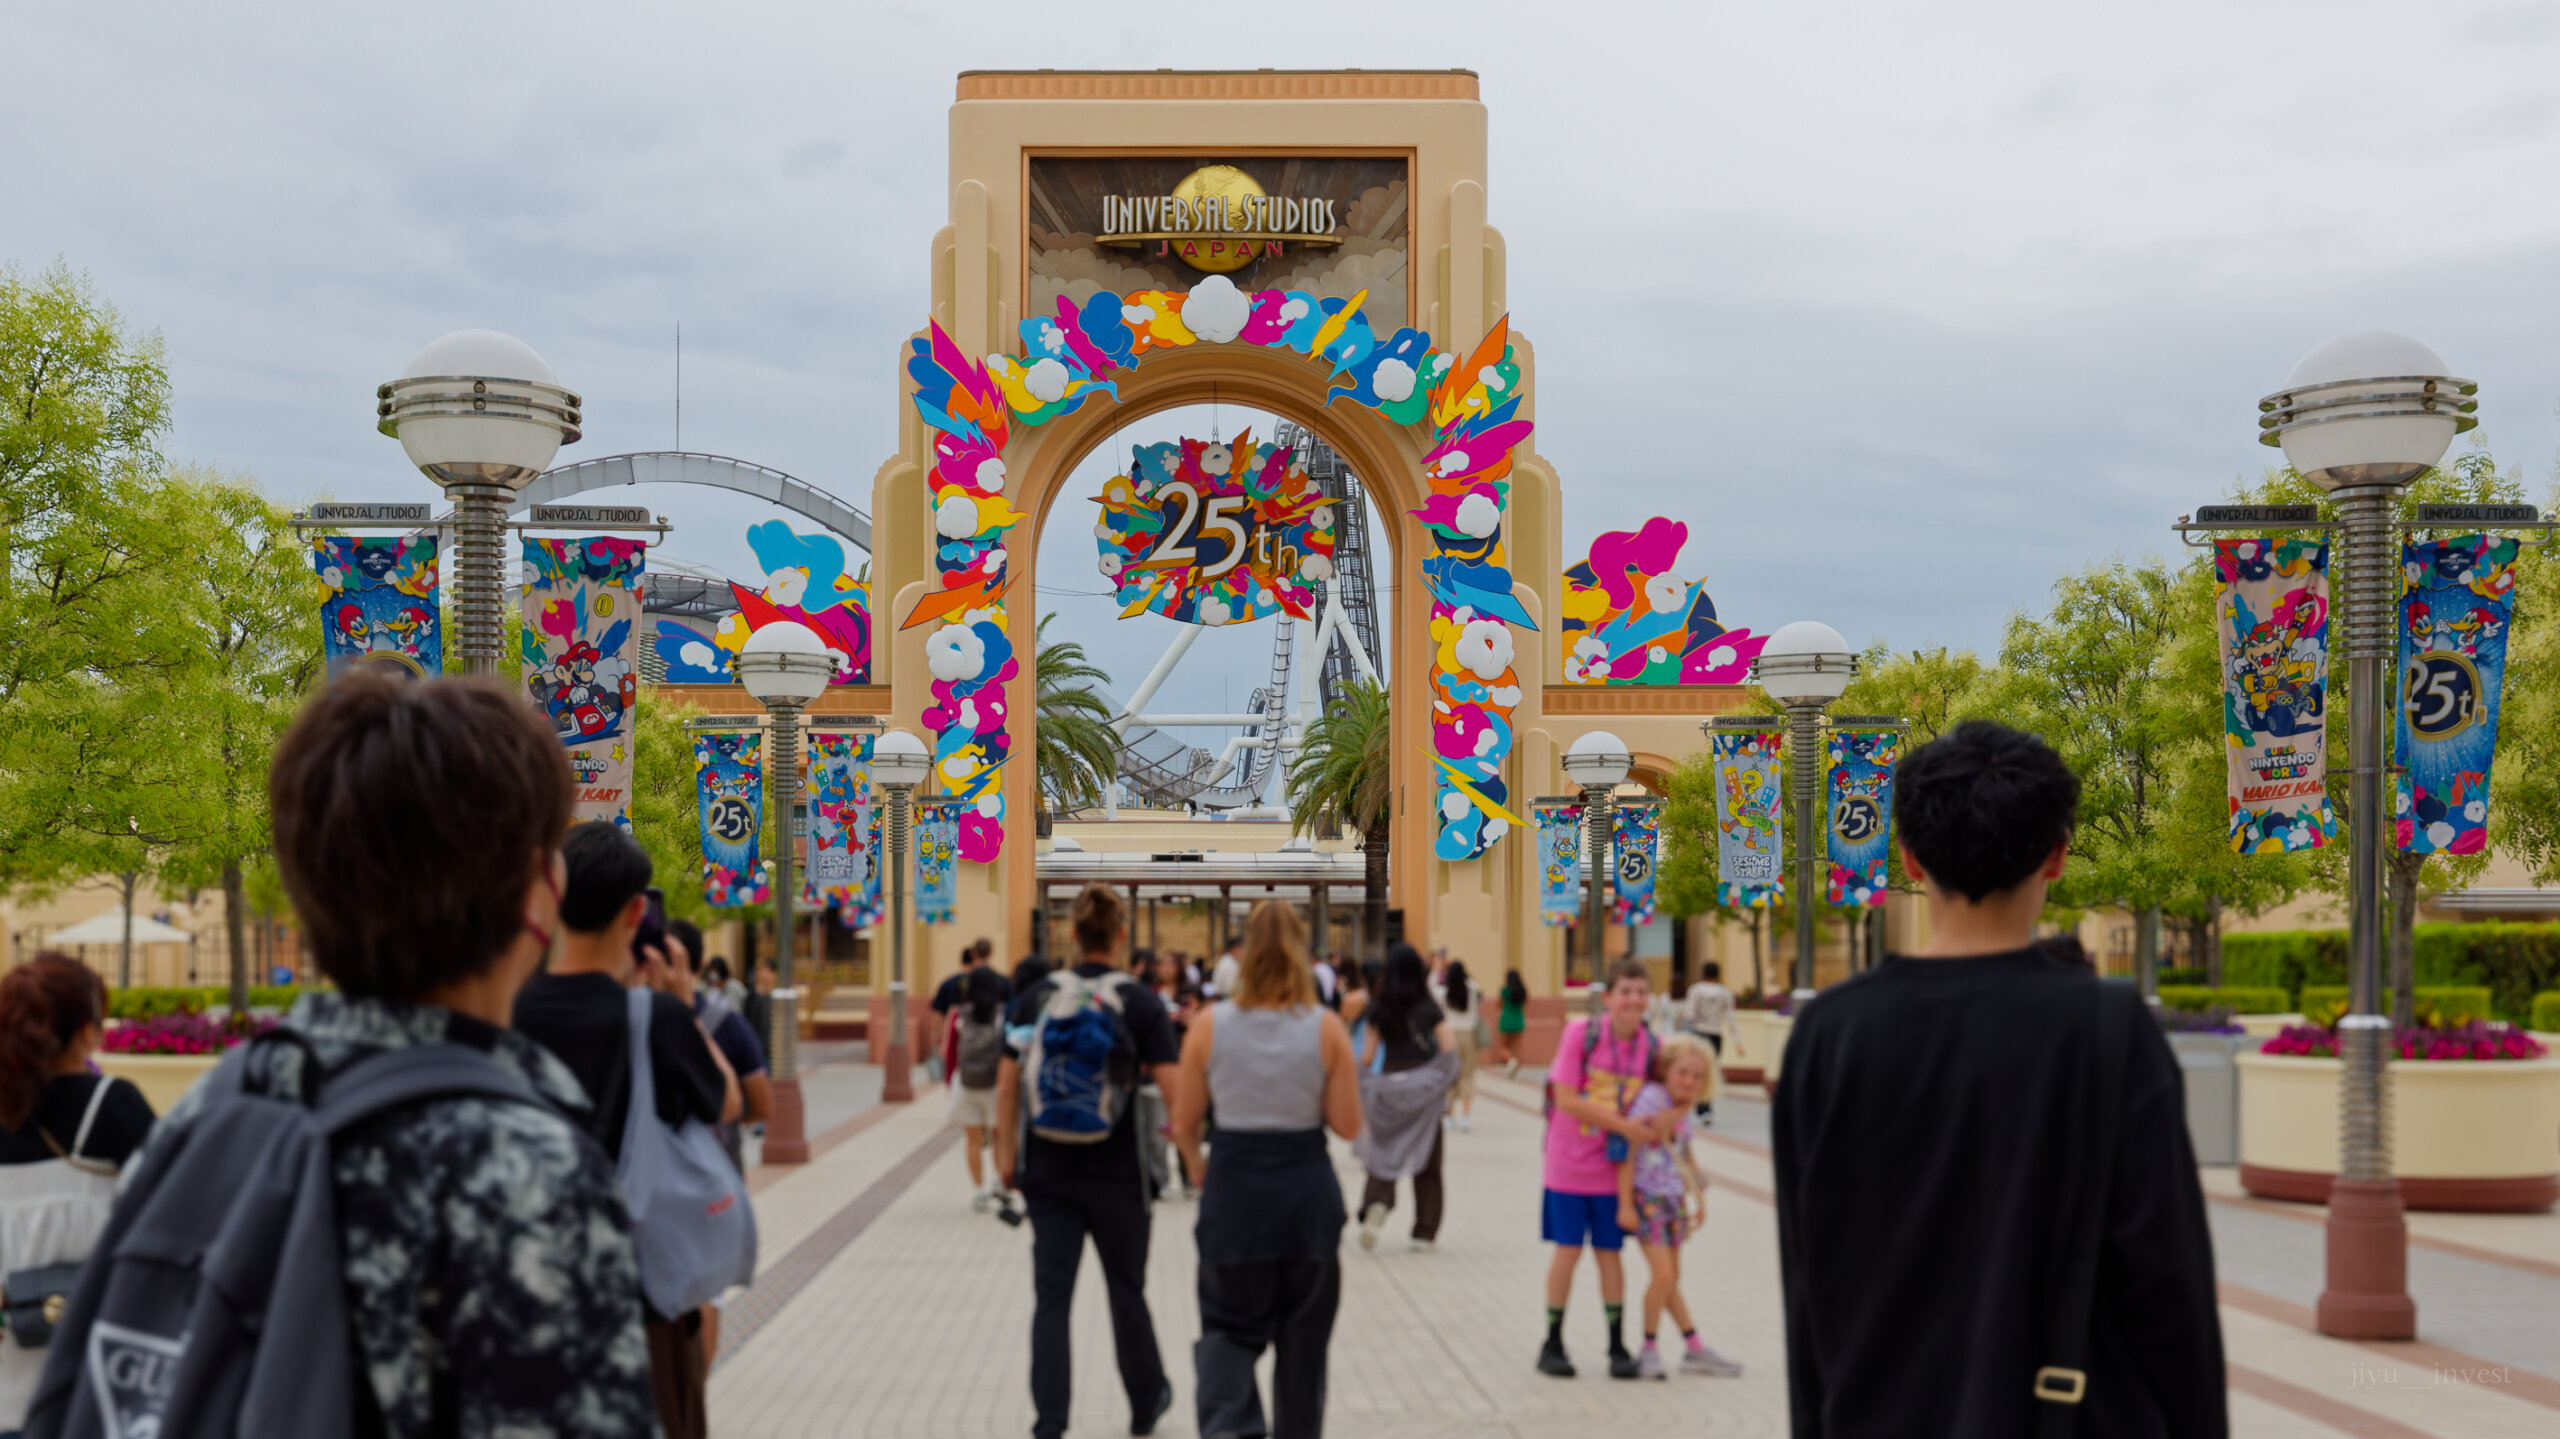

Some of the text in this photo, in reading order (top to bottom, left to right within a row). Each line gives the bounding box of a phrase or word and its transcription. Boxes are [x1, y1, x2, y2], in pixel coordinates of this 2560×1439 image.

[1103, 193, 1337, 235] UNIVERSAL STUDIOS
[1156, 240, 1283, 258] JAPAN
[317, 506, 425, 519] UNIVERSAL STUDIOS
[536, 508, 644, 522] UNIVERSAL STUDIOS
[2203, 507, 2312, 521] UNIVERSAL STUDIOS
[2424, 507, 2532, 520] UNIVERSAL STUDIOS
[1139, 480, 1299, 584] 25th
[568, 750, 592, 759] UPER
[2264, 745, 2297, 757] SUPER
[571, 759, 609, 773] ENDO
[2248, 752, 2317, 772] NINTENDO
[573, 770, 598, 783] RLD
[2259, 765, 2308, 782] WORLD
[581, 787, 623, 801] KART
[2242, 783, 2294, 800] MARIO
